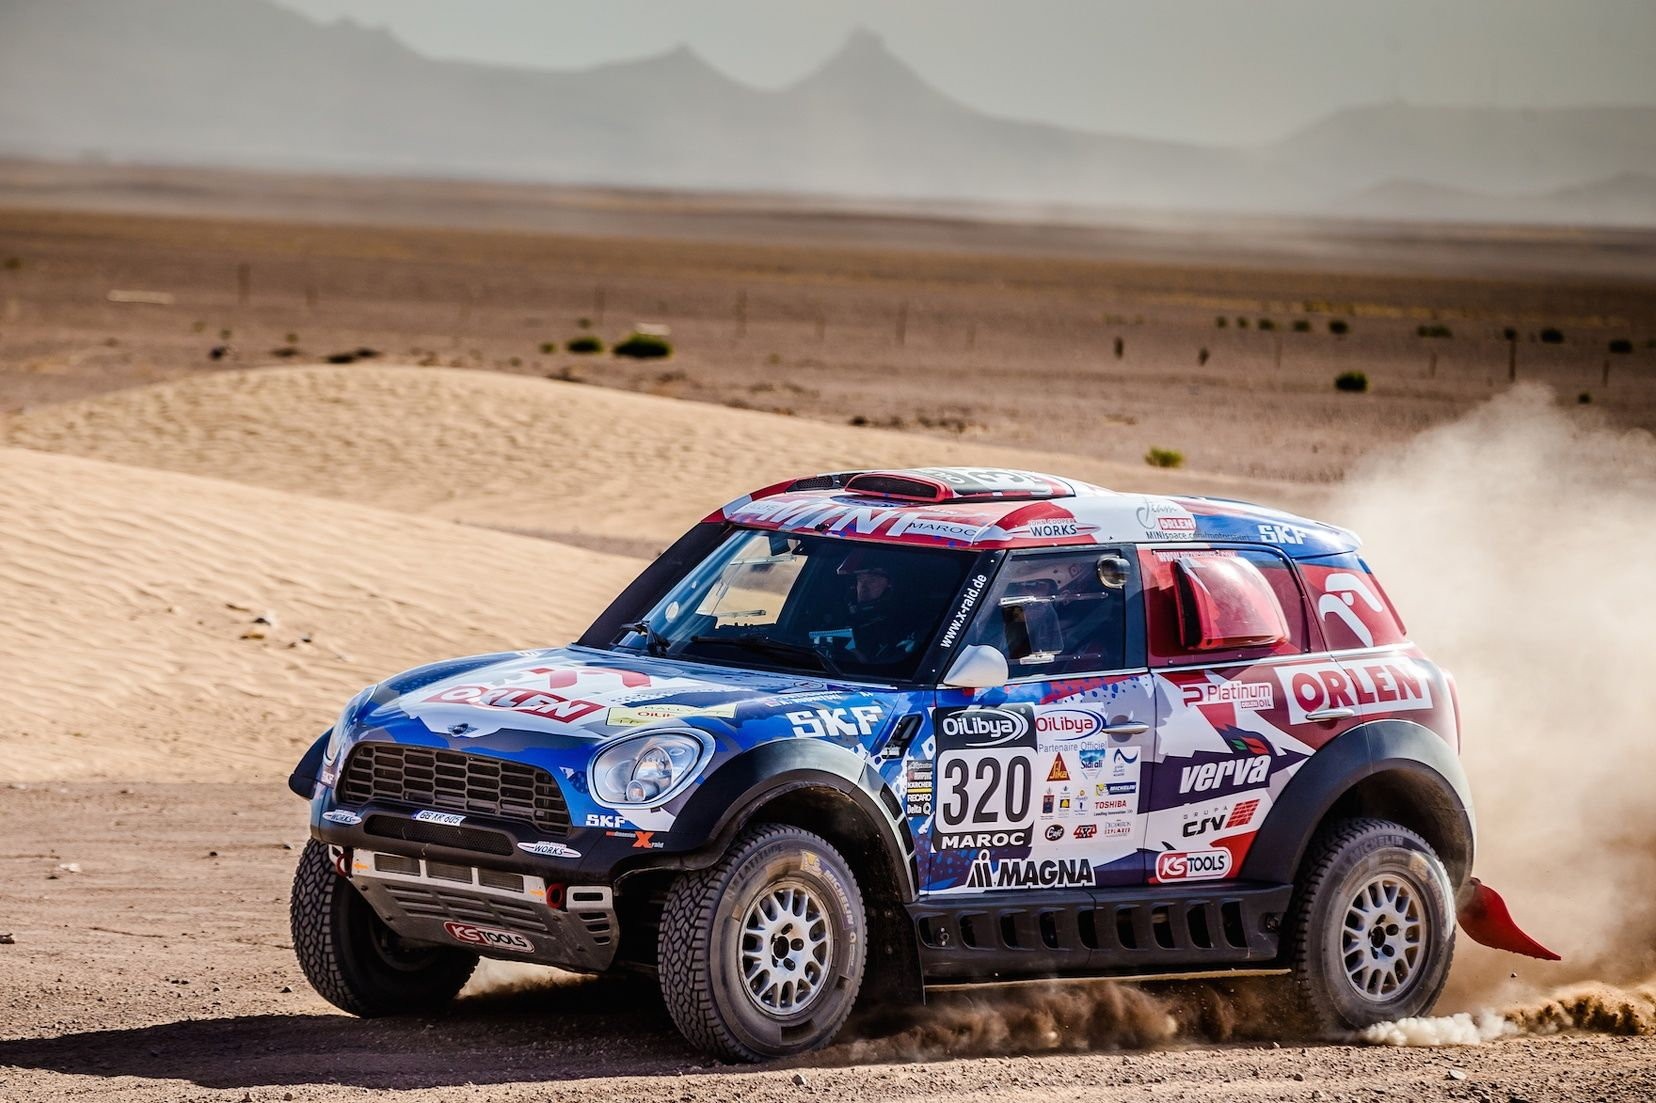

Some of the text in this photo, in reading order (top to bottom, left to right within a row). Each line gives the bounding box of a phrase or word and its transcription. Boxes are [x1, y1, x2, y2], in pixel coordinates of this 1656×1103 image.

[904, 521, 978, 537] MAROC
[1030, 524, 1077, 537] WORKS
[1257, 523, 1306, 545] SKF
[940, 573, 987, 650] www.x-raid.de
[1207, 683, 1271, 702] Platinum
[1291, 664, 1424, 713] ORLEN
[440, 687, 587, 718] ORLEN
[1259, 699, 1272, 708] OIL
[786, 705, 883, 738] SKF
[943, 717, 1014, 738] OiLibya
[1036, 716, 1094, 733] OiLibya
[1039, 743, 1078, 753] Partenaire
[1179, 754, 1272, 794] verva
[907, 793, 932, 802] RECARO
[943, 755, 1032, 826] 320
[922, 802, 931, 816] Q
[1095, 800, 1127, 809] TOSHIBA
[586, 814, 628, 828] SKF
[534, 844, 564, 856] WORKS
[941, 831, 1025, 850] MAROC
[996, 858, 1096, 888] MAGNA
[1161, 855, 1225, 876] KS TOOLS
[824, 869, 855, 926] MICHELIN
[451, 924, 528, 948] KS TOOLS
